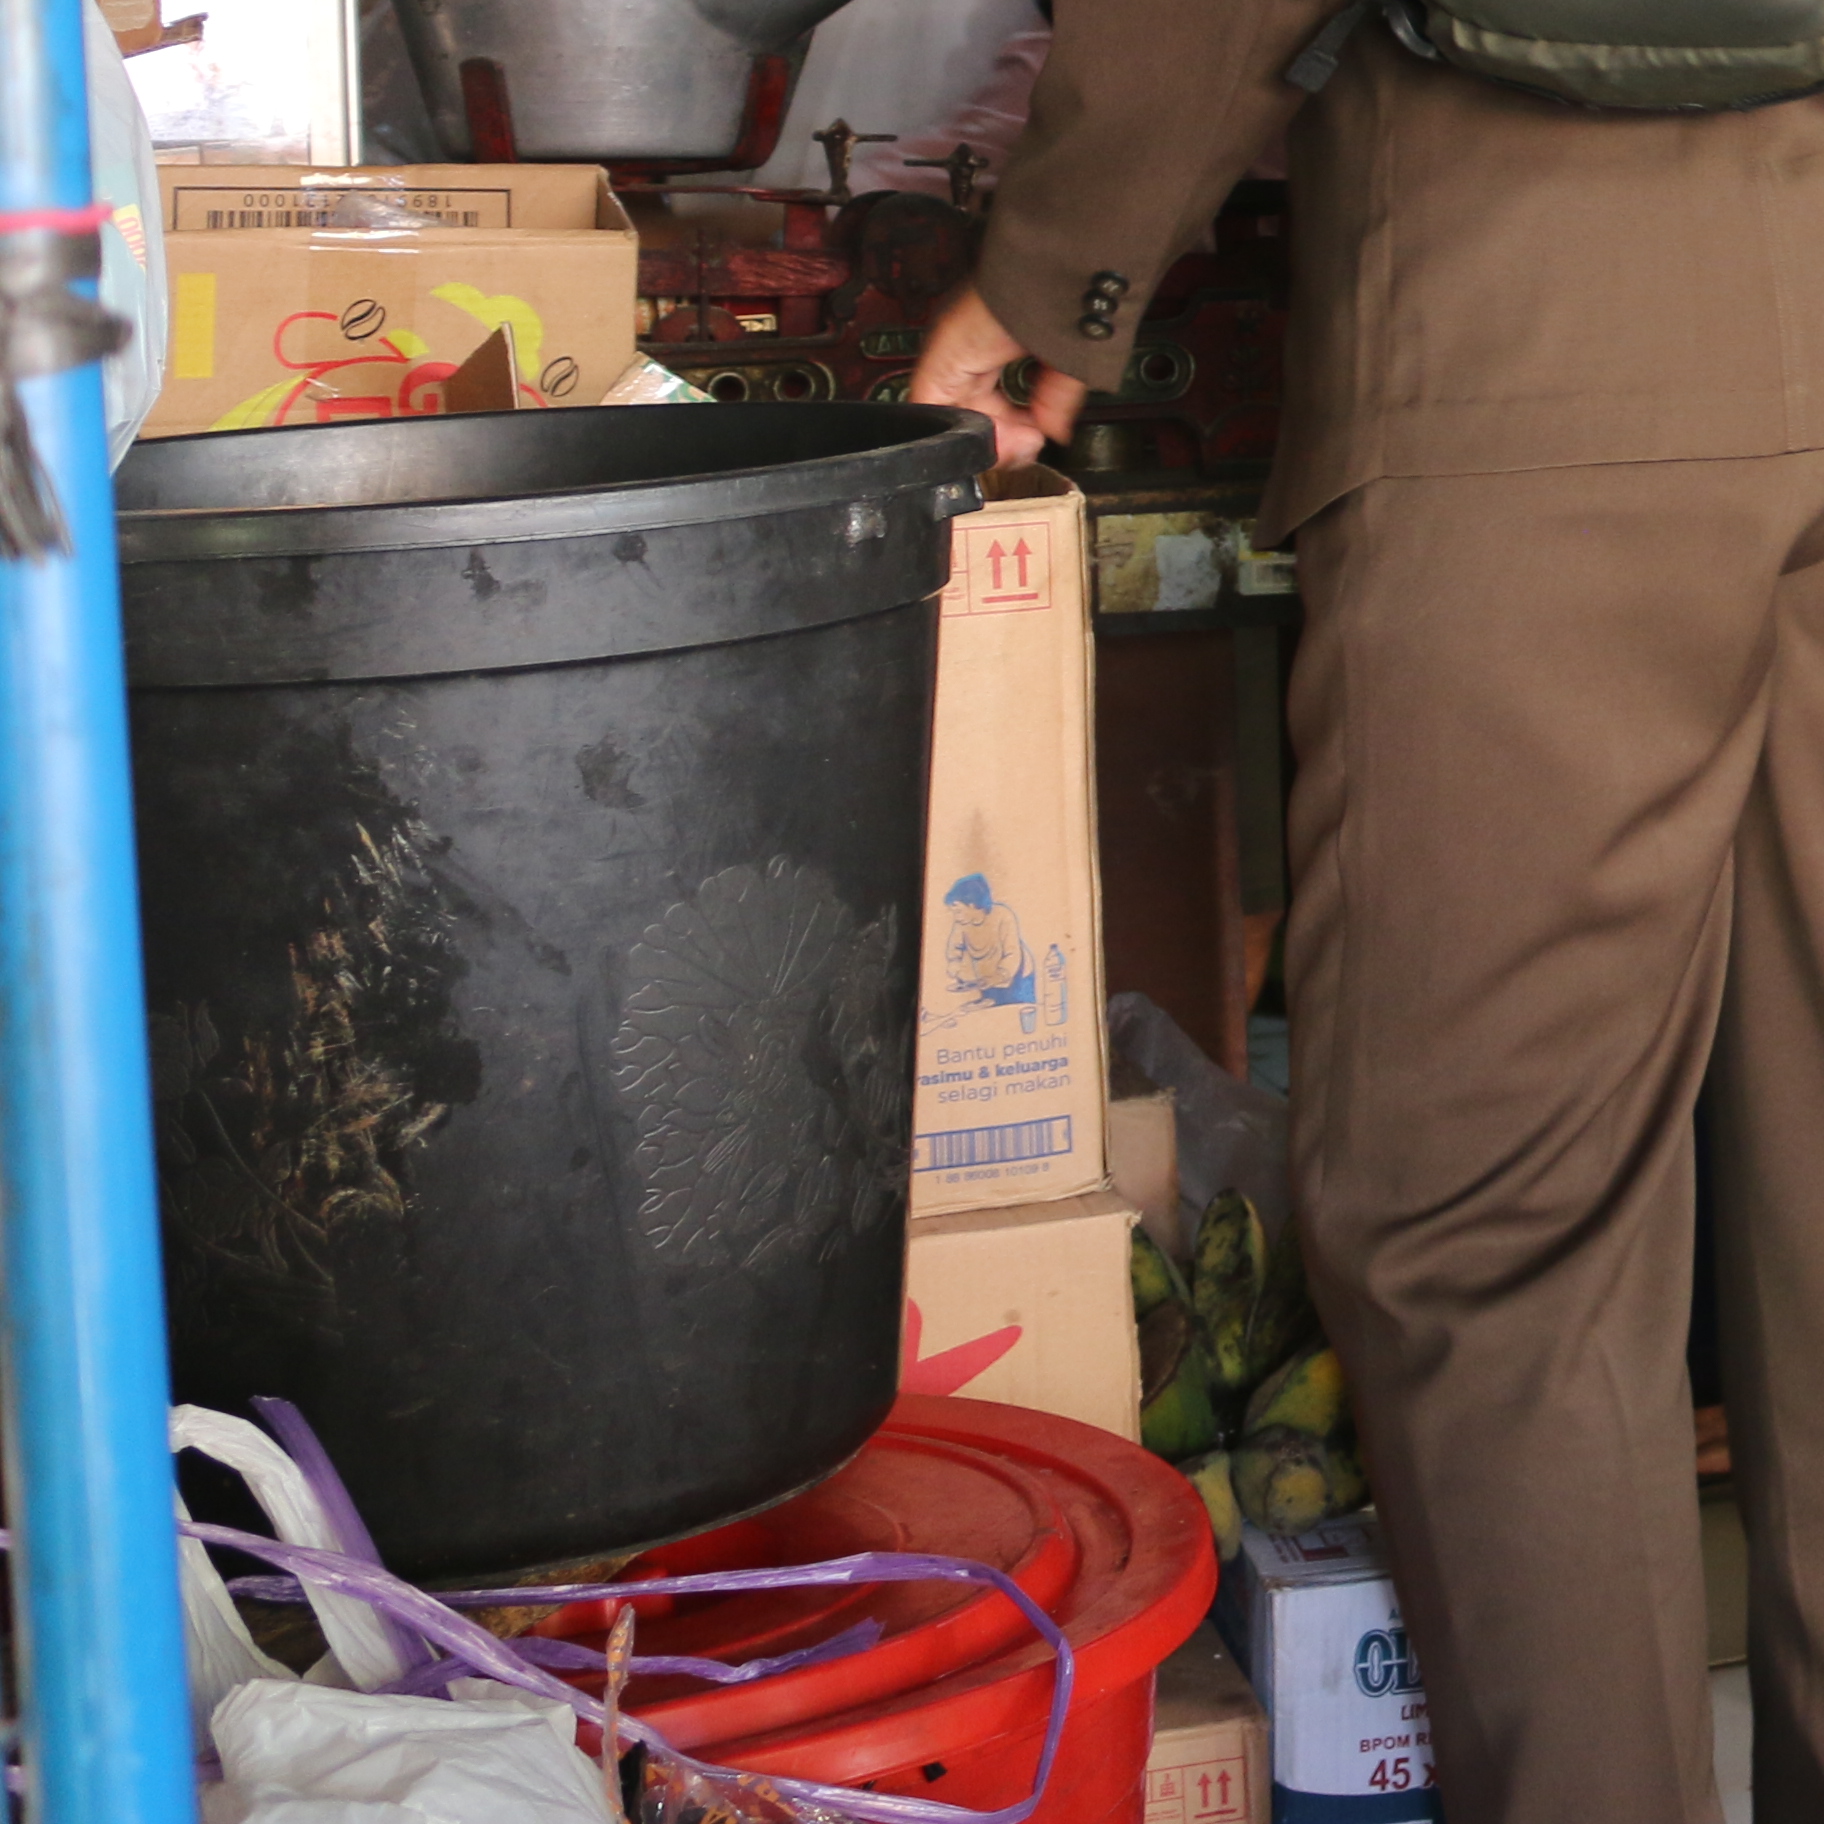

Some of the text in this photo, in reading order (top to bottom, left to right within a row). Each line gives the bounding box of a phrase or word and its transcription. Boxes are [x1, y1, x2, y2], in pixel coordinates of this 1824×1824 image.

[937, 1032, 1069, 1065] Bantu penuhi
[977, 1065, 992, 1079] &
[995, 1056, 1070, 1080] keluarga
[937, 1072, 1071, 1104] selagi makan
[1359, 1734, 1411, 1753] BPOM
[1368, 1757, 1412, 1792] 45
